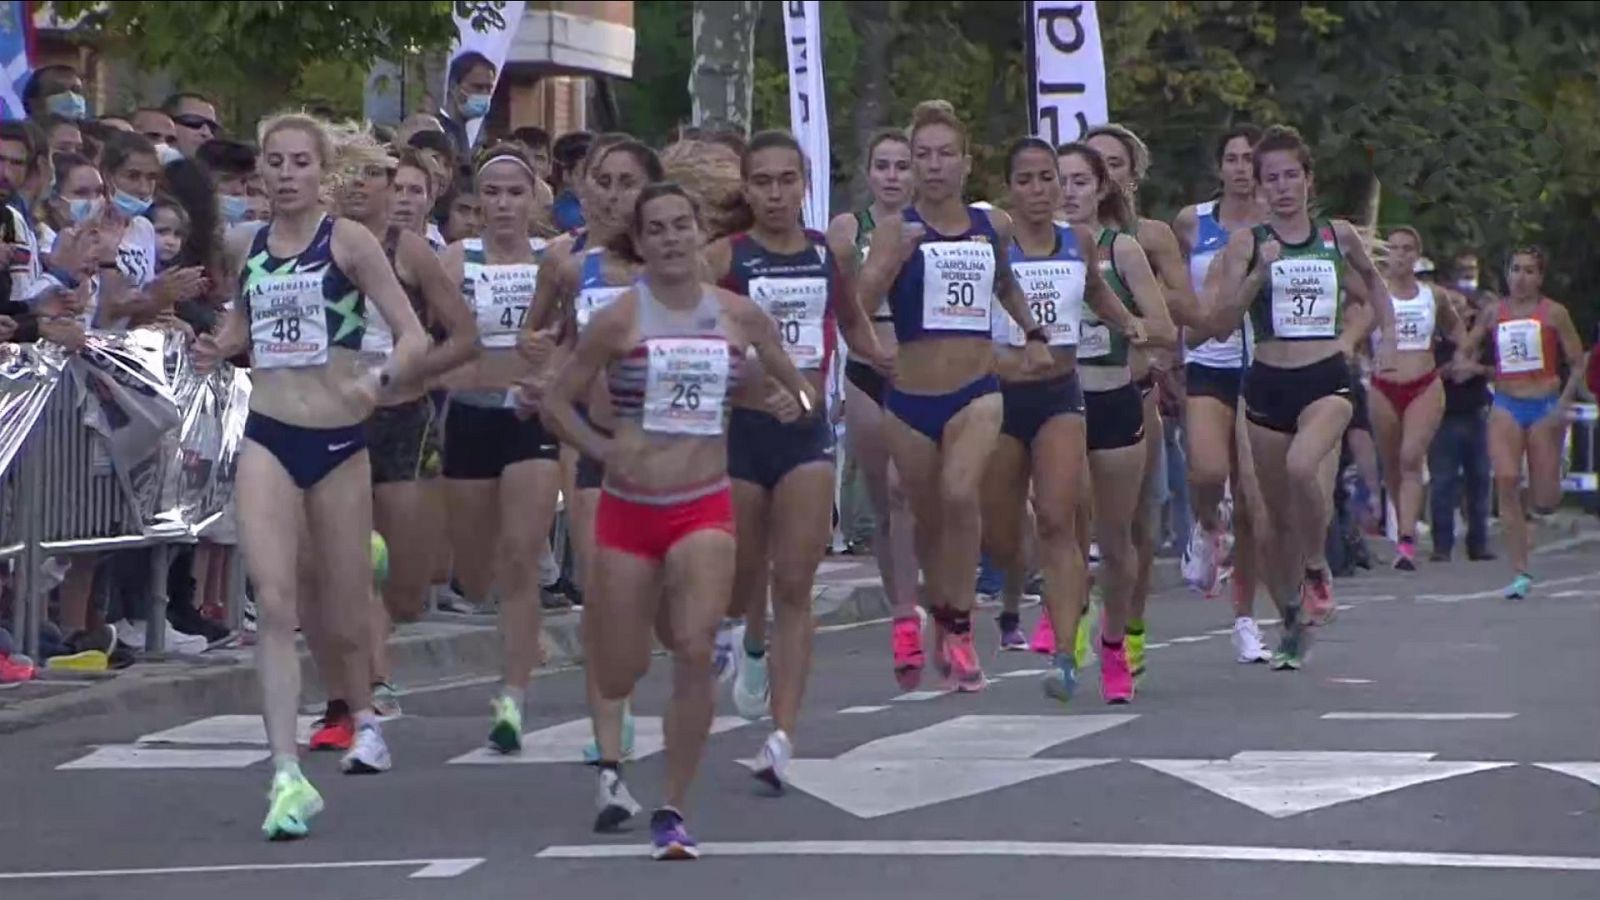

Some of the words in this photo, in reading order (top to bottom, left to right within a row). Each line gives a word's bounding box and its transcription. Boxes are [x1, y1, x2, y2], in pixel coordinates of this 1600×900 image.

[935, 260, 986, 271] CAROLINA
[941, 271, 982, 281] ROBLES
[1290, 278, 1320, 286] CLARA
[270, 295, 298, 306] ELISE
[946, 281, 975, 307] 50
[1292, 294, 1317, 317] 37
[500, 305, 529, 329] 47
[1030, 300, 1057, 324] 38
[271, 316, 301, 342] 48
[671, 383, 701, 410] 26
